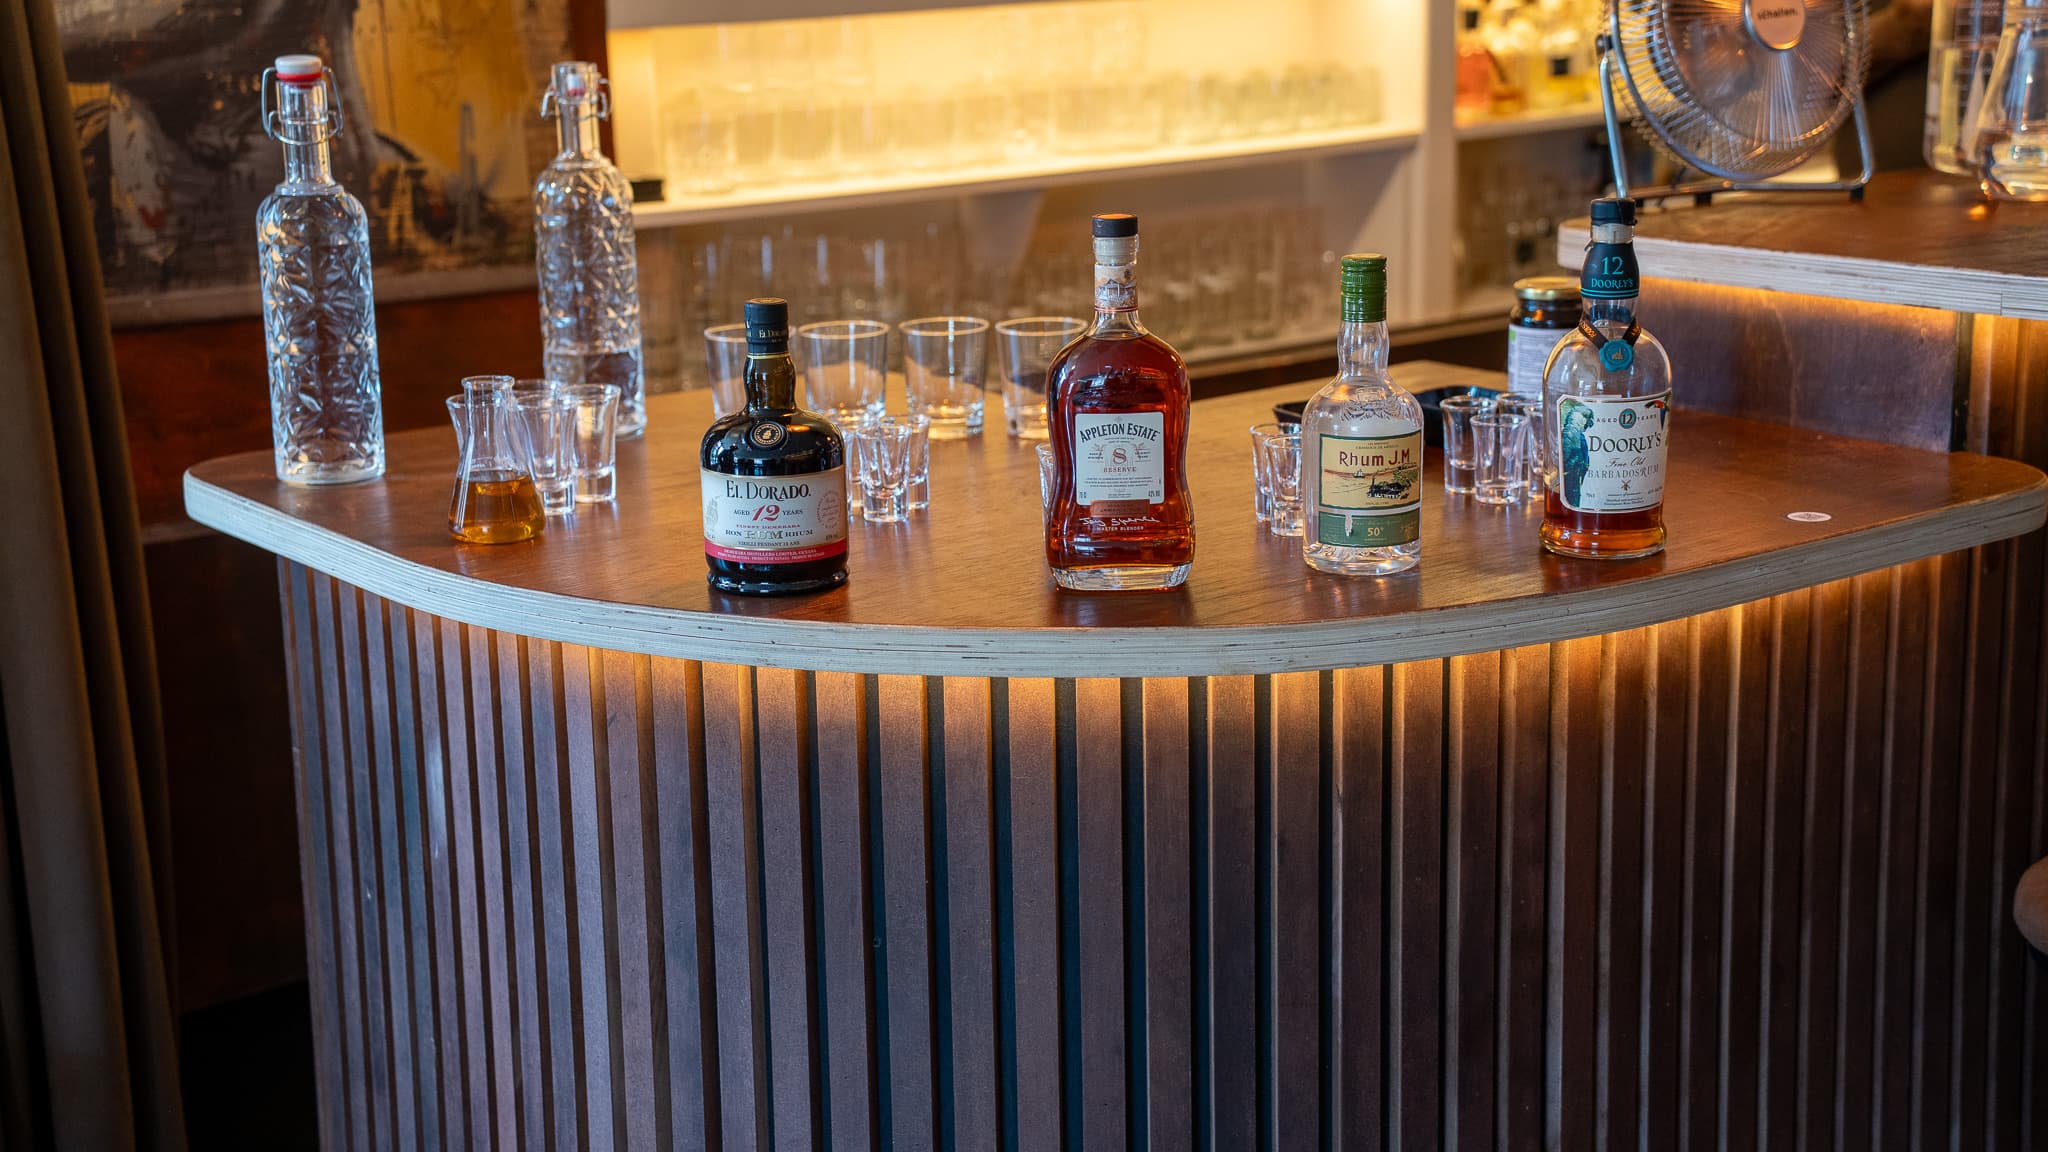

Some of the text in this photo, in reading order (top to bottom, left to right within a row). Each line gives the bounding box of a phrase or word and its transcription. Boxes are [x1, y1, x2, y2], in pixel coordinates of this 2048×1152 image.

[1601, 256, 1624, 275] 12
[1591, 278, 1634, 289] DOORLY'S
[1621, 413, 1633, 425] 12
[1637, 413, 1657, 421] YEARS
[1080, 422, 1158, 443] APPLETON ESTATE
[1588, 431, 1662, 453] DOORLY'S
[1339, 447, 1410, 467] Rhum J.M
[1605, 456, 1647, 467] Fine Old
[1588, 463, 1659, 479] BARBADOS RUM
[726, 479, 743, 499] EL
[751, 504, 781, 522] 12
[782, 508, 804, 516] YEARS
[725, 529, 742, 537] RON
[744, 530, 784, 540] RUM
[785, 529, 814, 537] RHUM
